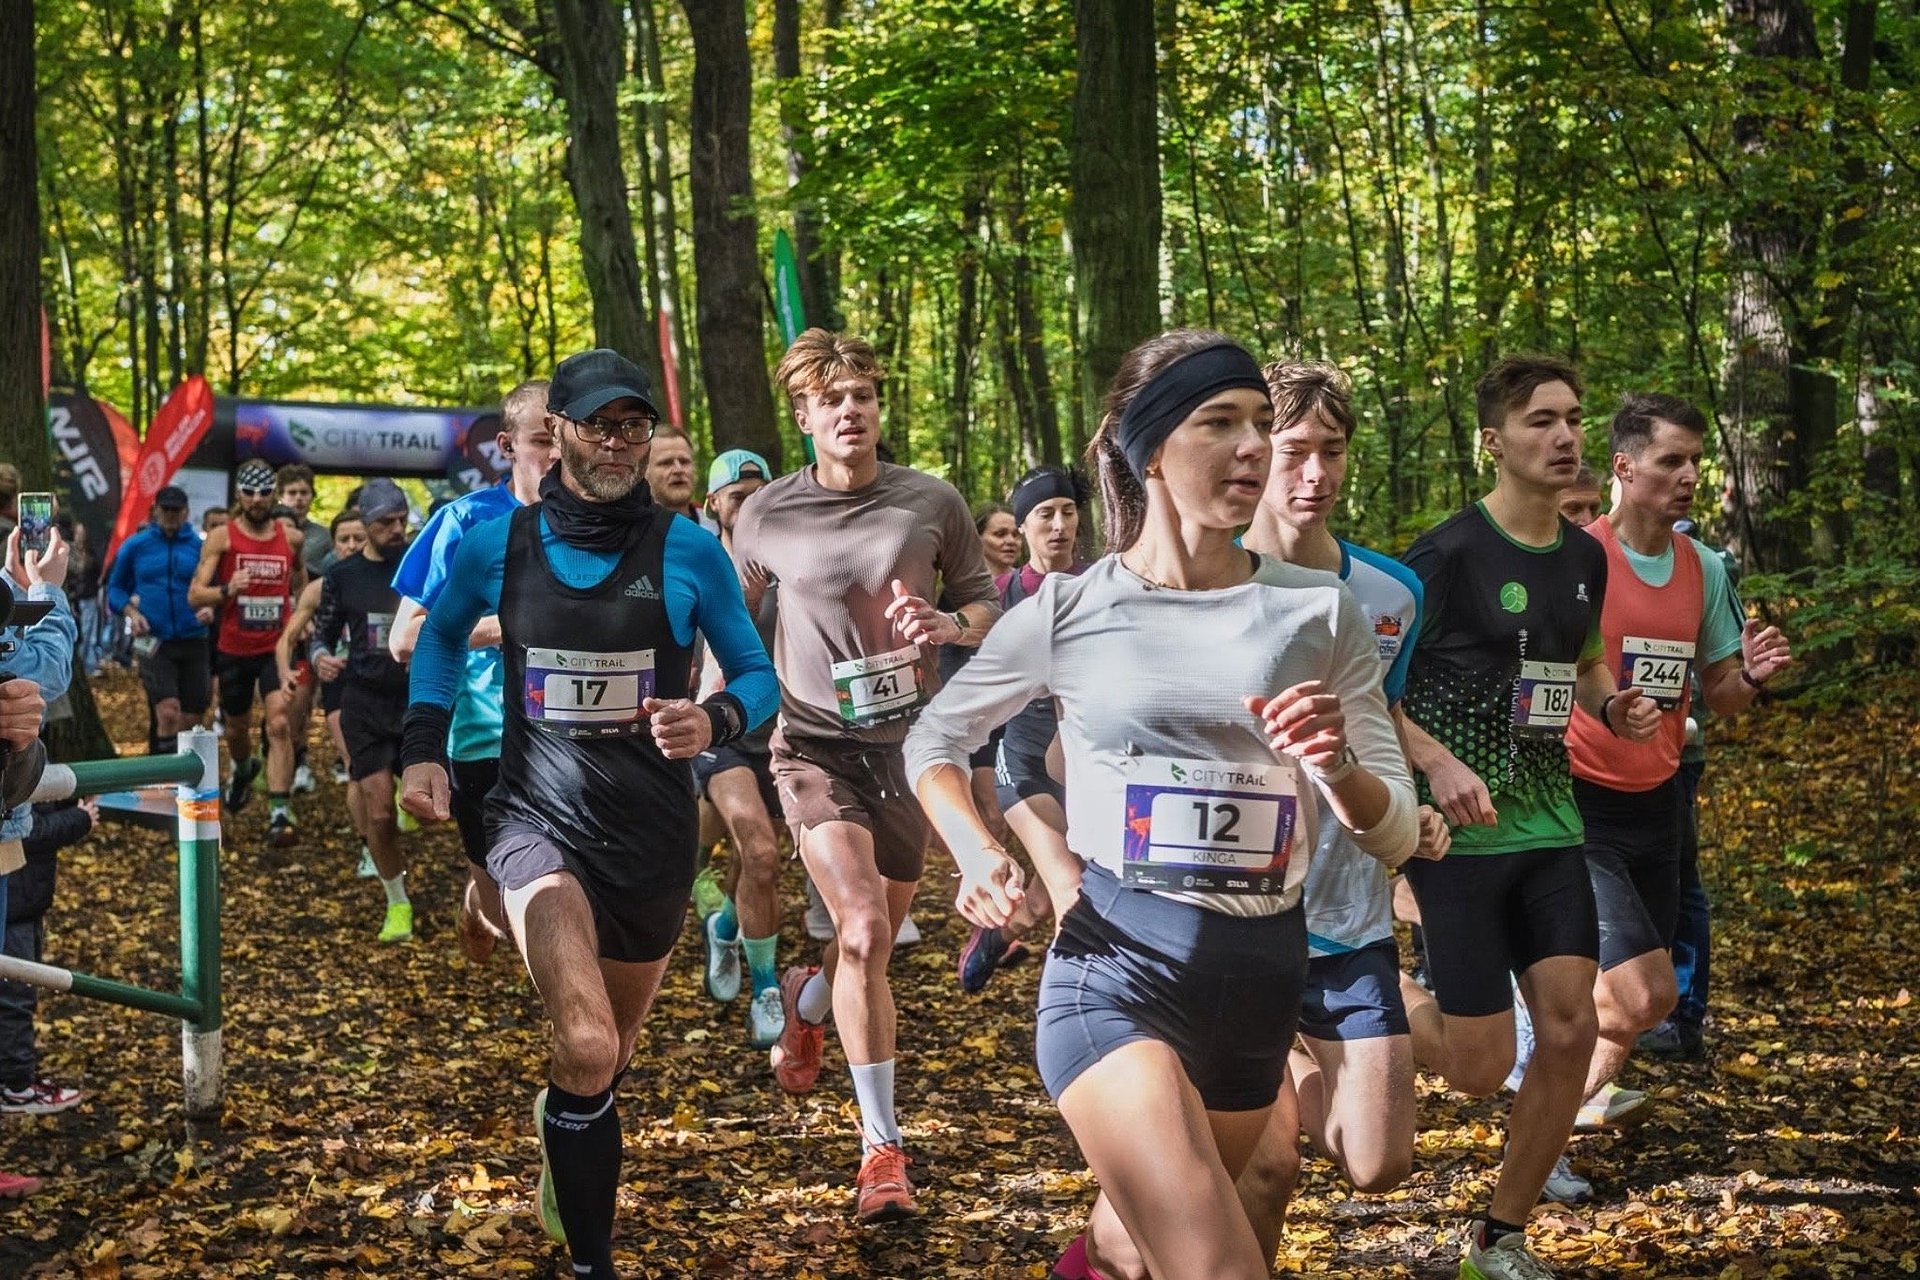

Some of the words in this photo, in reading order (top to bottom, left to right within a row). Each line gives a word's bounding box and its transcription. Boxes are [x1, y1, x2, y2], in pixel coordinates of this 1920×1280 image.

[624, 588, 660, 600] adidas
[873, 673, 899, 697] 41
[1639, 661, 1681, 685] 244
[571, 679, 609, 706] 17
[1543, 688, 1569, 712] 182
[1193, 801, 1241, 843] 12
[1193, 852, 1237, 865] KINGA
